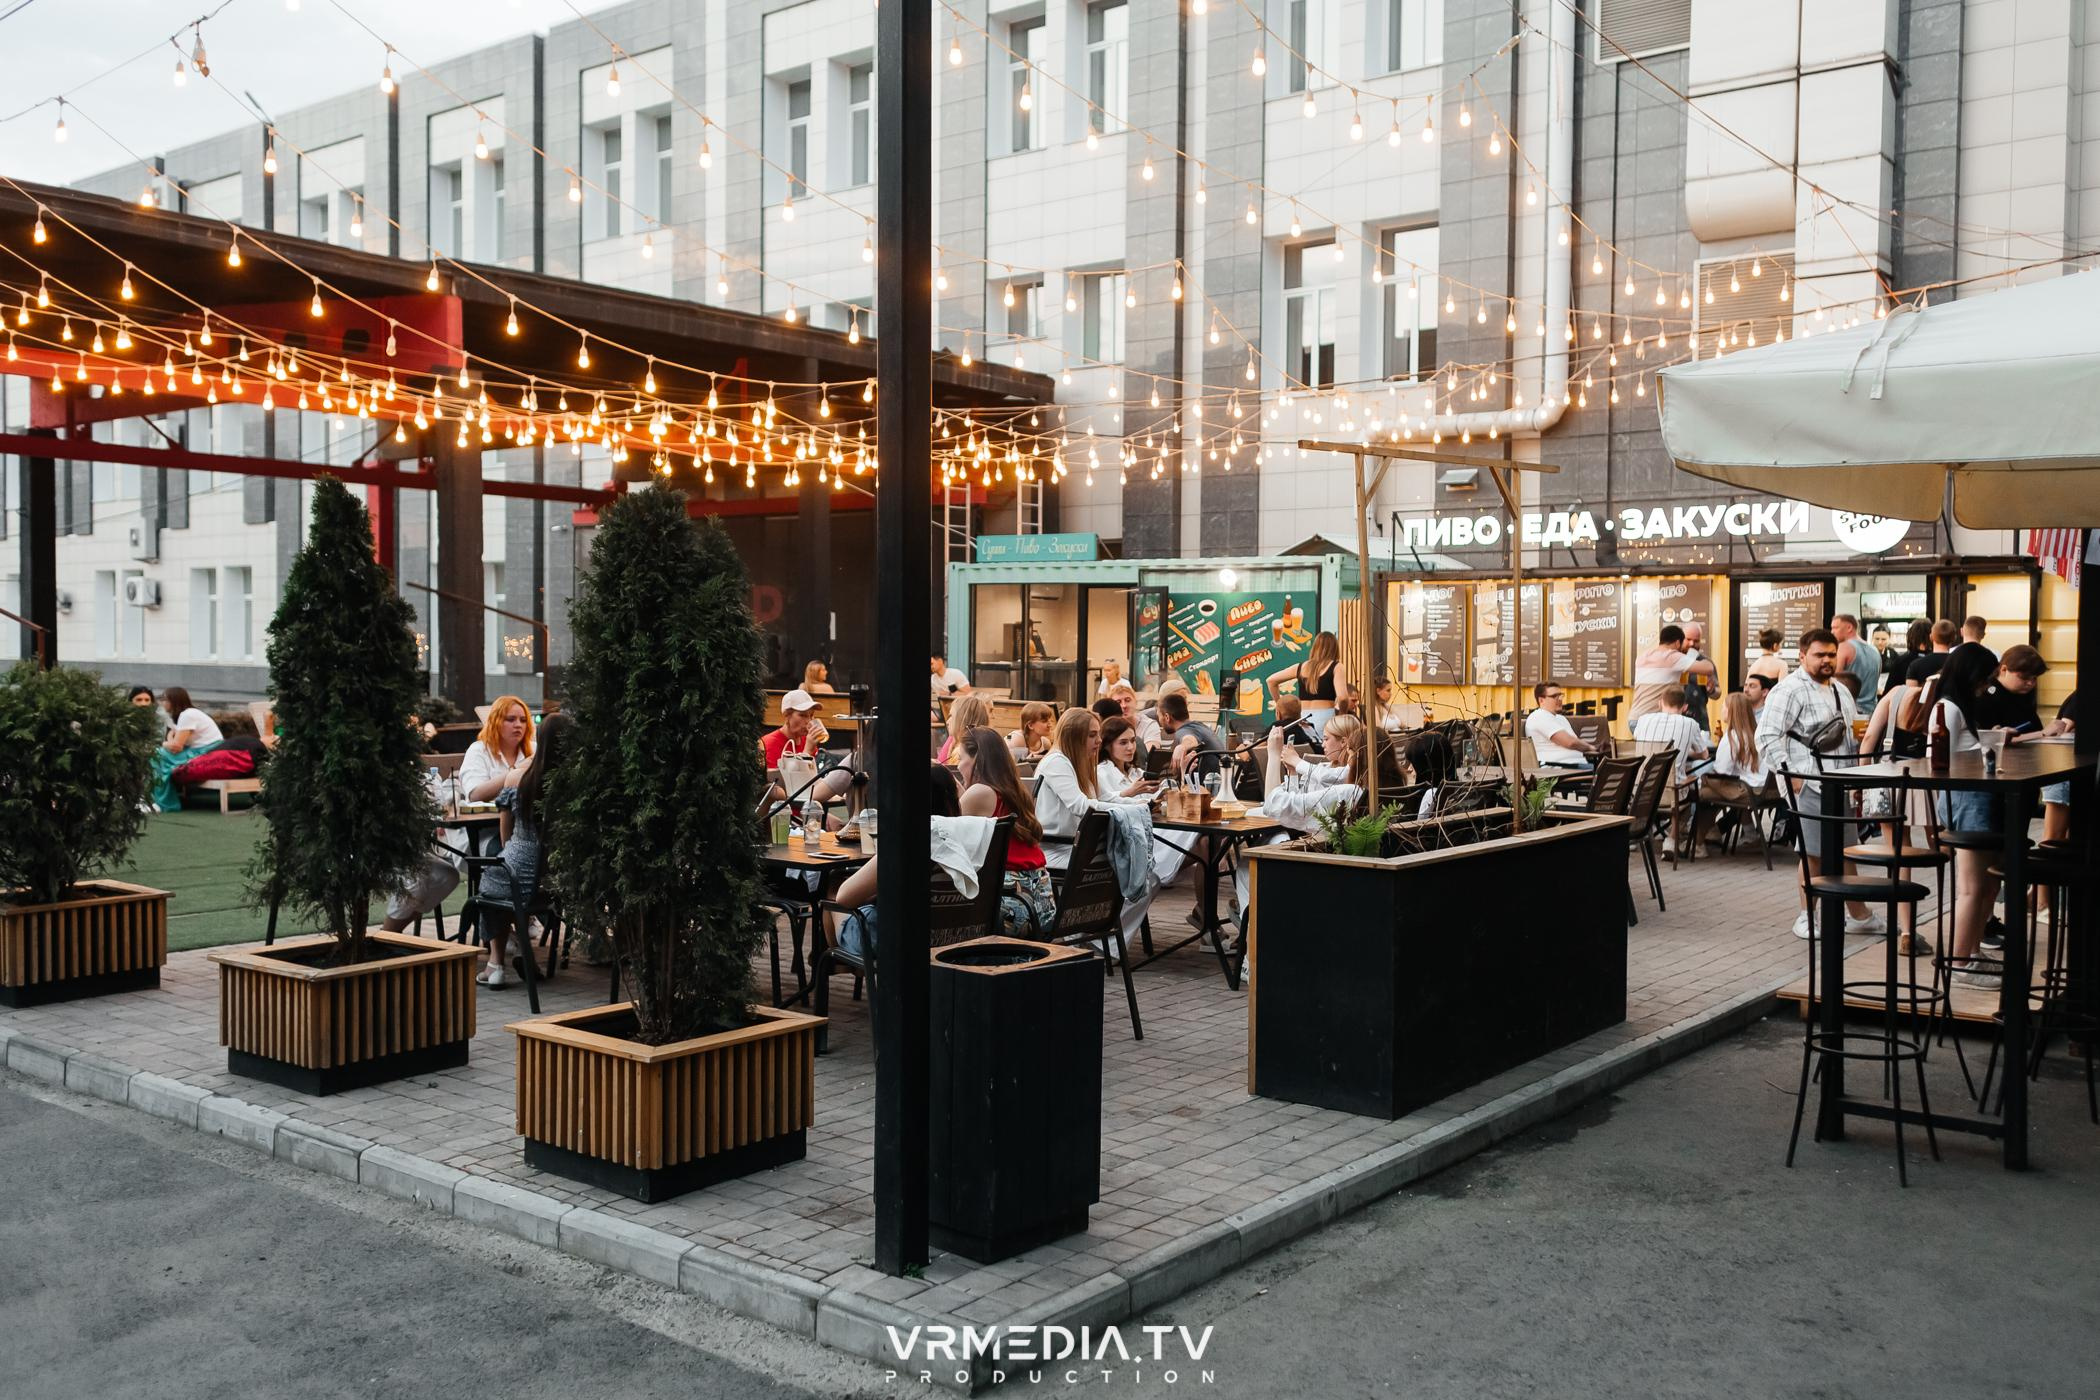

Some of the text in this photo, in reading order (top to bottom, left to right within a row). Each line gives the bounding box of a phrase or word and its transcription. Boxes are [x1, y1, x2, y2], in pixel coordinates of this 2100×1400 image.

[1404, 500, 1810, 548] ПИВО ЕДА ЗАКУСКИ
[1015, 537, 1041, 554] Пиво
[1048, 536, 1089, 560] Закуски
[1230, 600, 1262, 621] Пиво
[1234, 650, 1273, 673] Снеки
